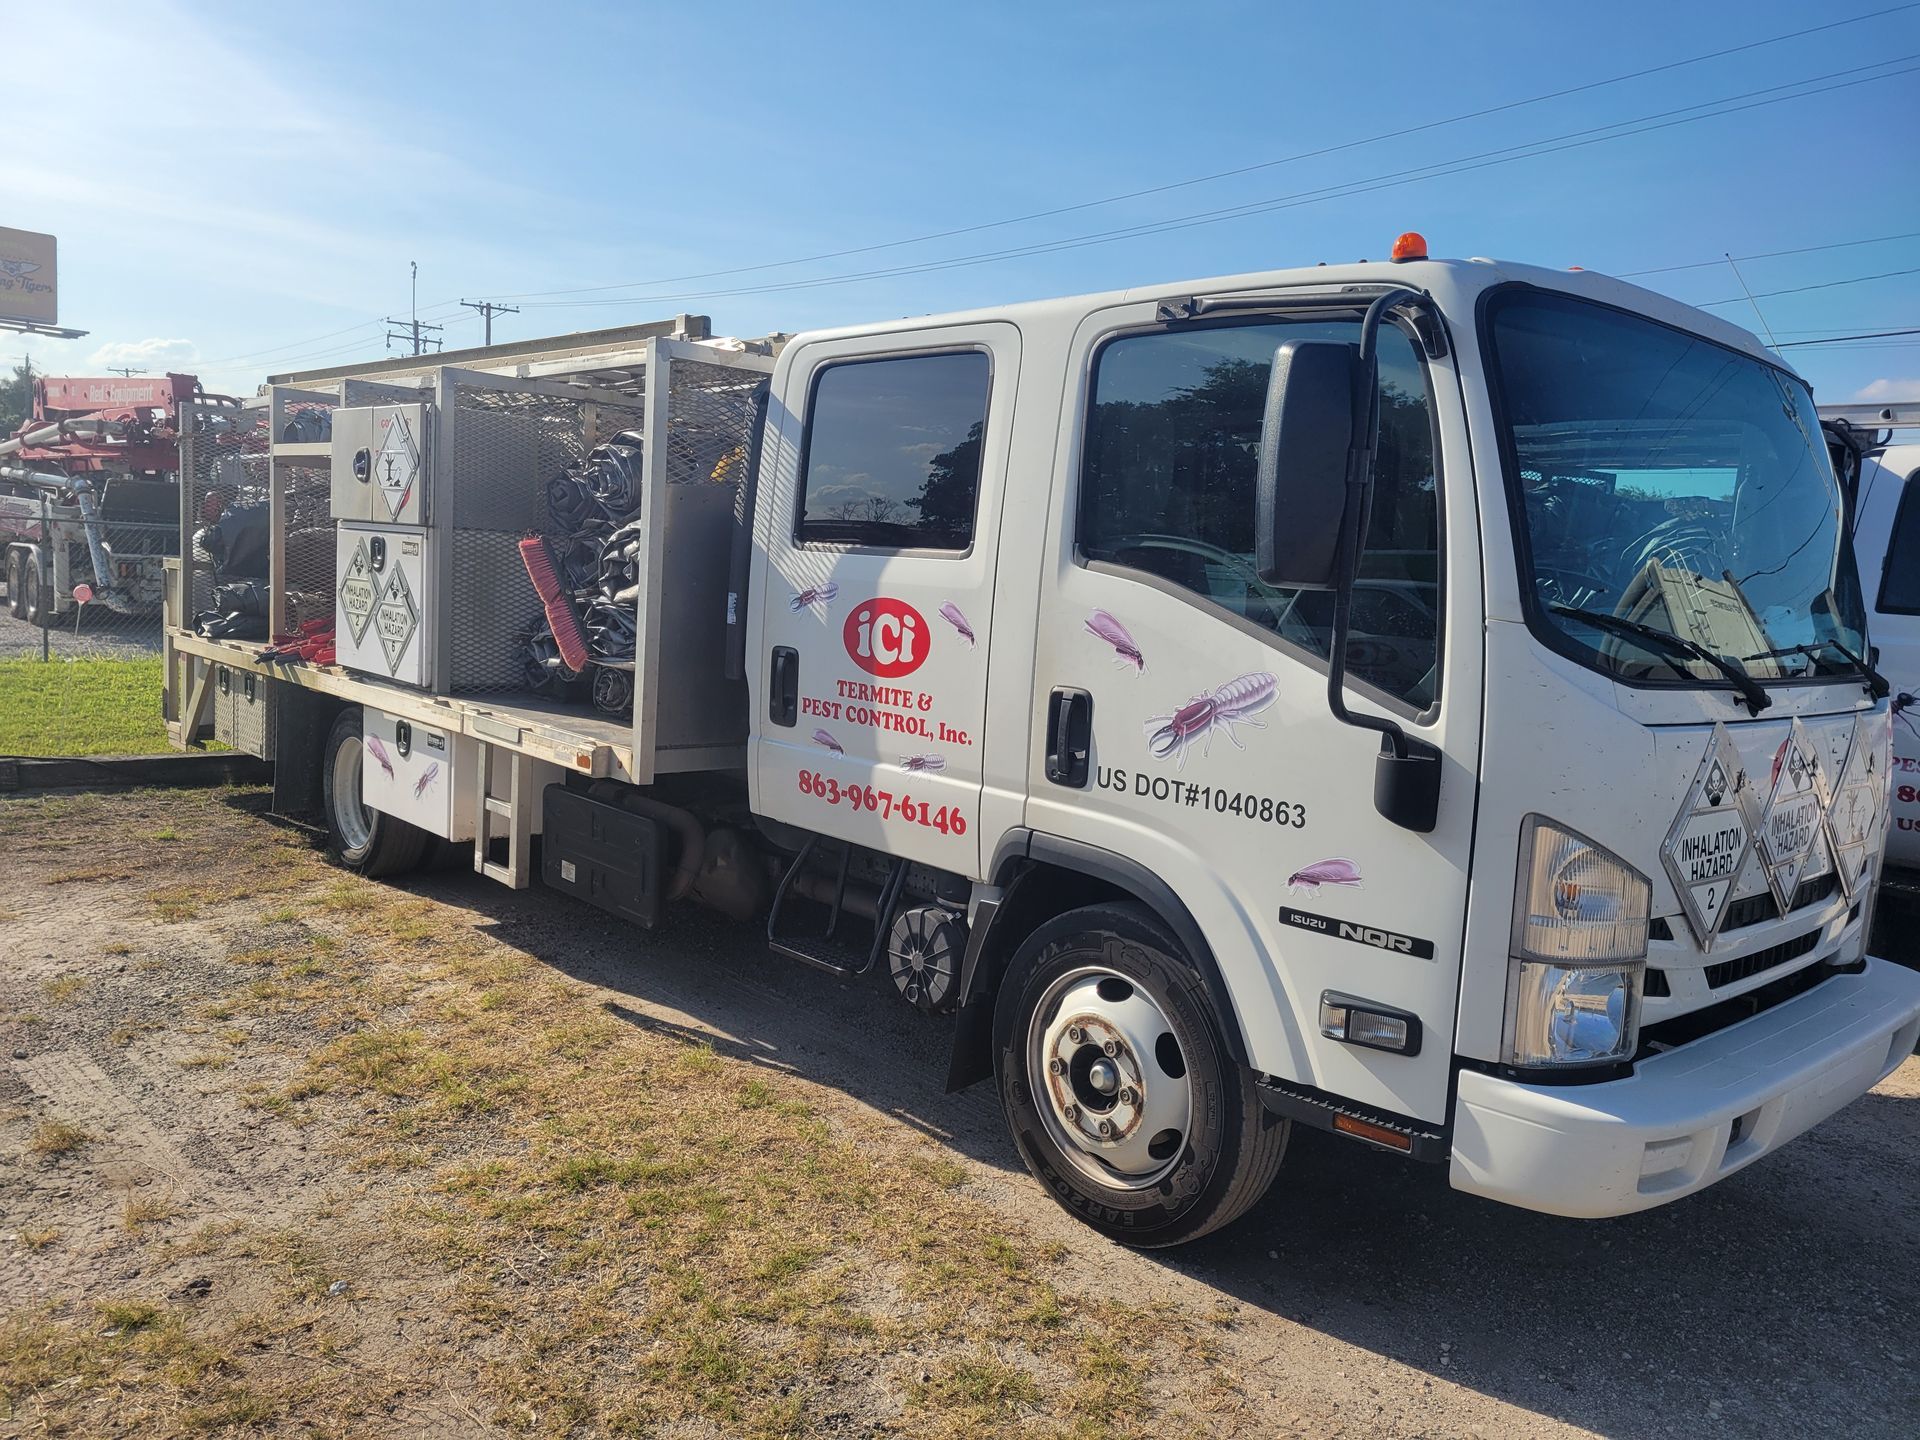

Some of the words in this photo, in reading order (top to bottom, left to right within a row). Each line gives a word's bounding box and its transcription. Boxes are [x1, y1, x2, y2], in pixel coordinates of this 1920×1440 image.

[16, 276, 52, 294] Tigers
[345, 584, 372, 601] INHALATION
[348, 596, 368, 612] HAZARD
[355, 614, 361, 627] 2
[380, 608, 408, 626] INHALATION
[384, 622, 404, 638] HAZARD
[390, 640, 396, 653] 6
[837, 679, 912, 709] TERMITE
[917, 692, 933, 711] &
[802, 697, 842, 720] PEST
[845, 705, 934, 742] CONTROL,
[938, 723, 972, 746] Inc.
[798, 769, 967, 836] 863-967-6146
[1097, 765, 1127, 793] US
[1135, 773, 1306, 829] DOT#1040863
[1897, 784, 1920, 803] 8
[1772, 801, 1818, 837] INHALATION
[1681, 826, 1742, 863] INHALATION
[1776, 825, 1810, 857] HAZARD
[1691, 853, 1734, 882] HAZARD
[1707, 887, 1715, 910] 2
[1290, 913, 1327, 930] ISUZU
[1338, 923, 1413, 952] NQR
